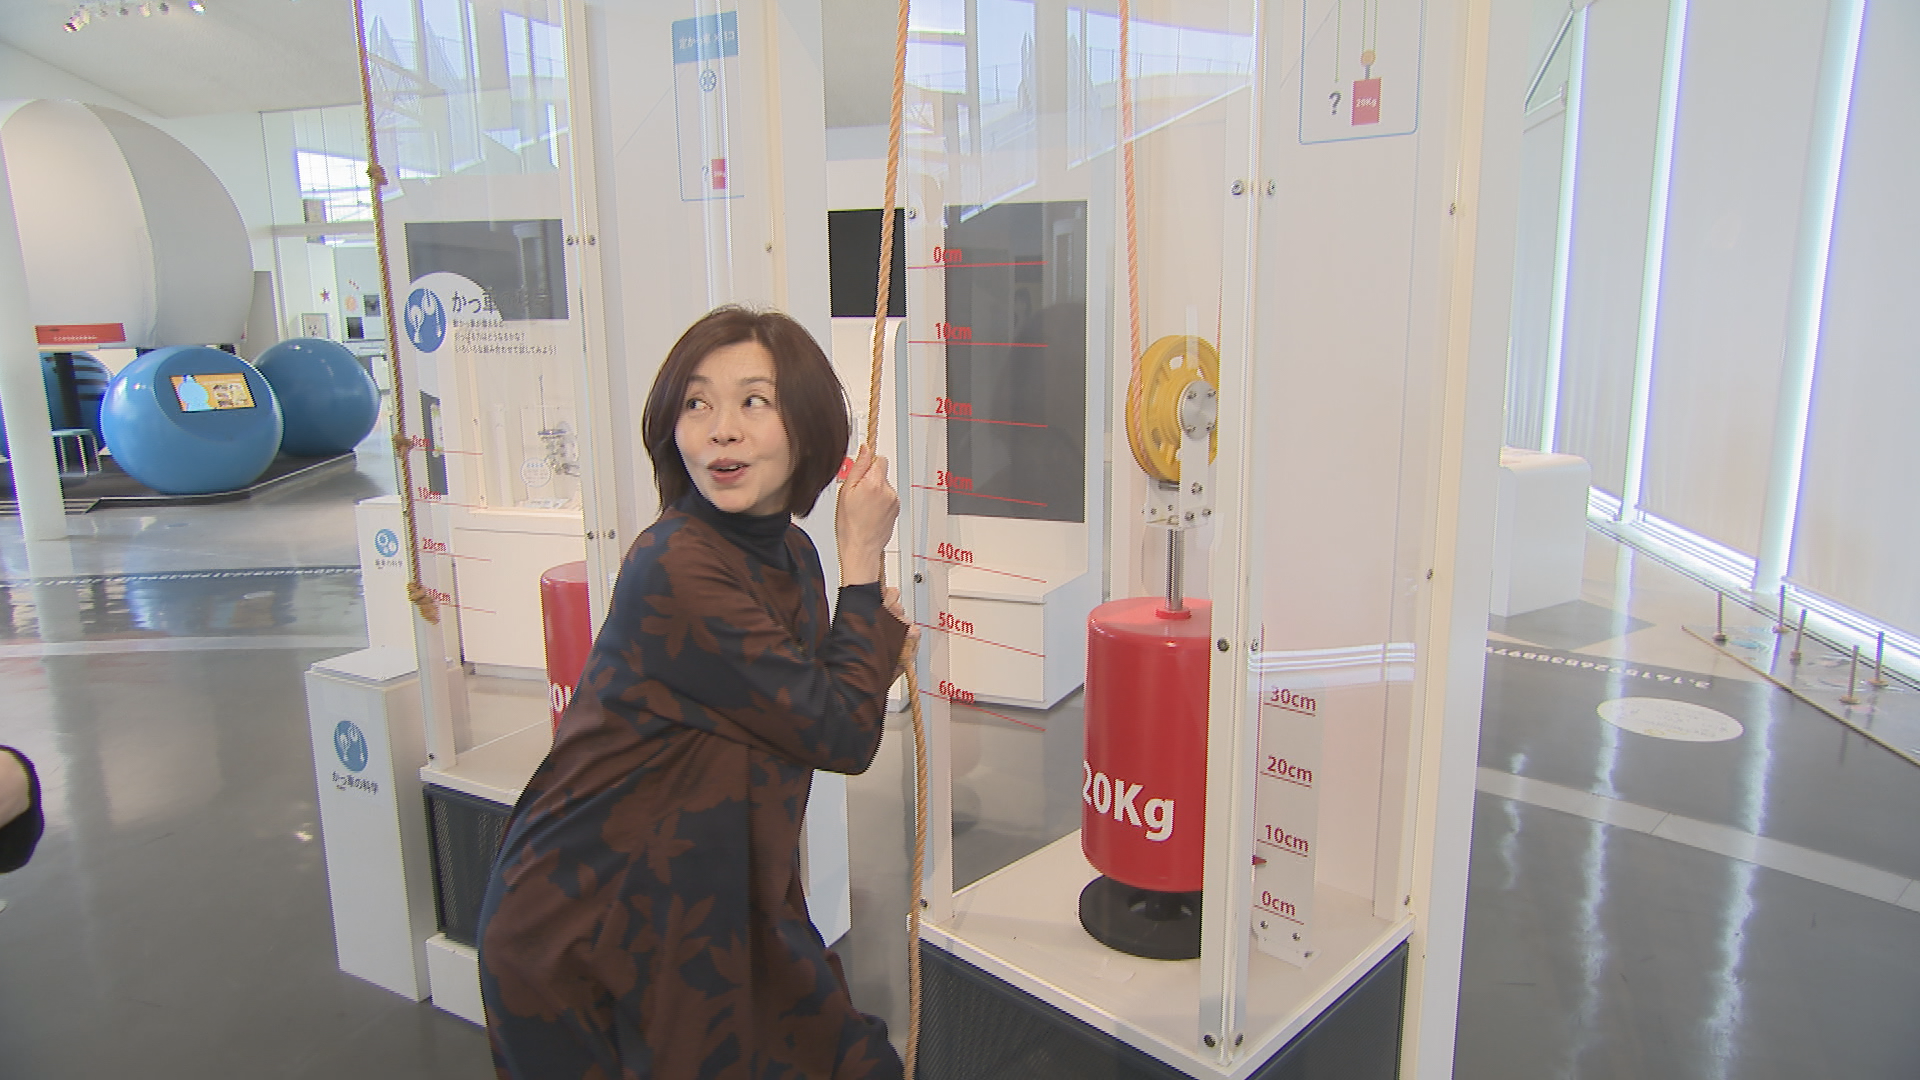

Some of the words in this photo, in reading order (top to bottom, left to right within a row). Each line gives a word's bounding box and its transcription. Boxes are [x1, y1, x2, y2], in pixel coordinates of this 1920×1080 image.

[933, 246, 963, 264] 0cm
[934, 322, 973, 341] 10cm
[935, 397, 973, 416] 20cm
[936, 470, 974, 491] 30cm
[417, 487, 442, 501] 10cm
[422, 537, 447, 552] 20cm
[937, 542, 974, 564] 40cm
[938, 611, 975, 635] 50cm
[938, 680, 975, 705] 60cm
[1269, 685, 1317, 712] 30cm
[1266, 755, 1313, 783] 20cm
[1264, 824, 1309, 853] 10cm
[1261, 890, 1296, 917] 0cm
